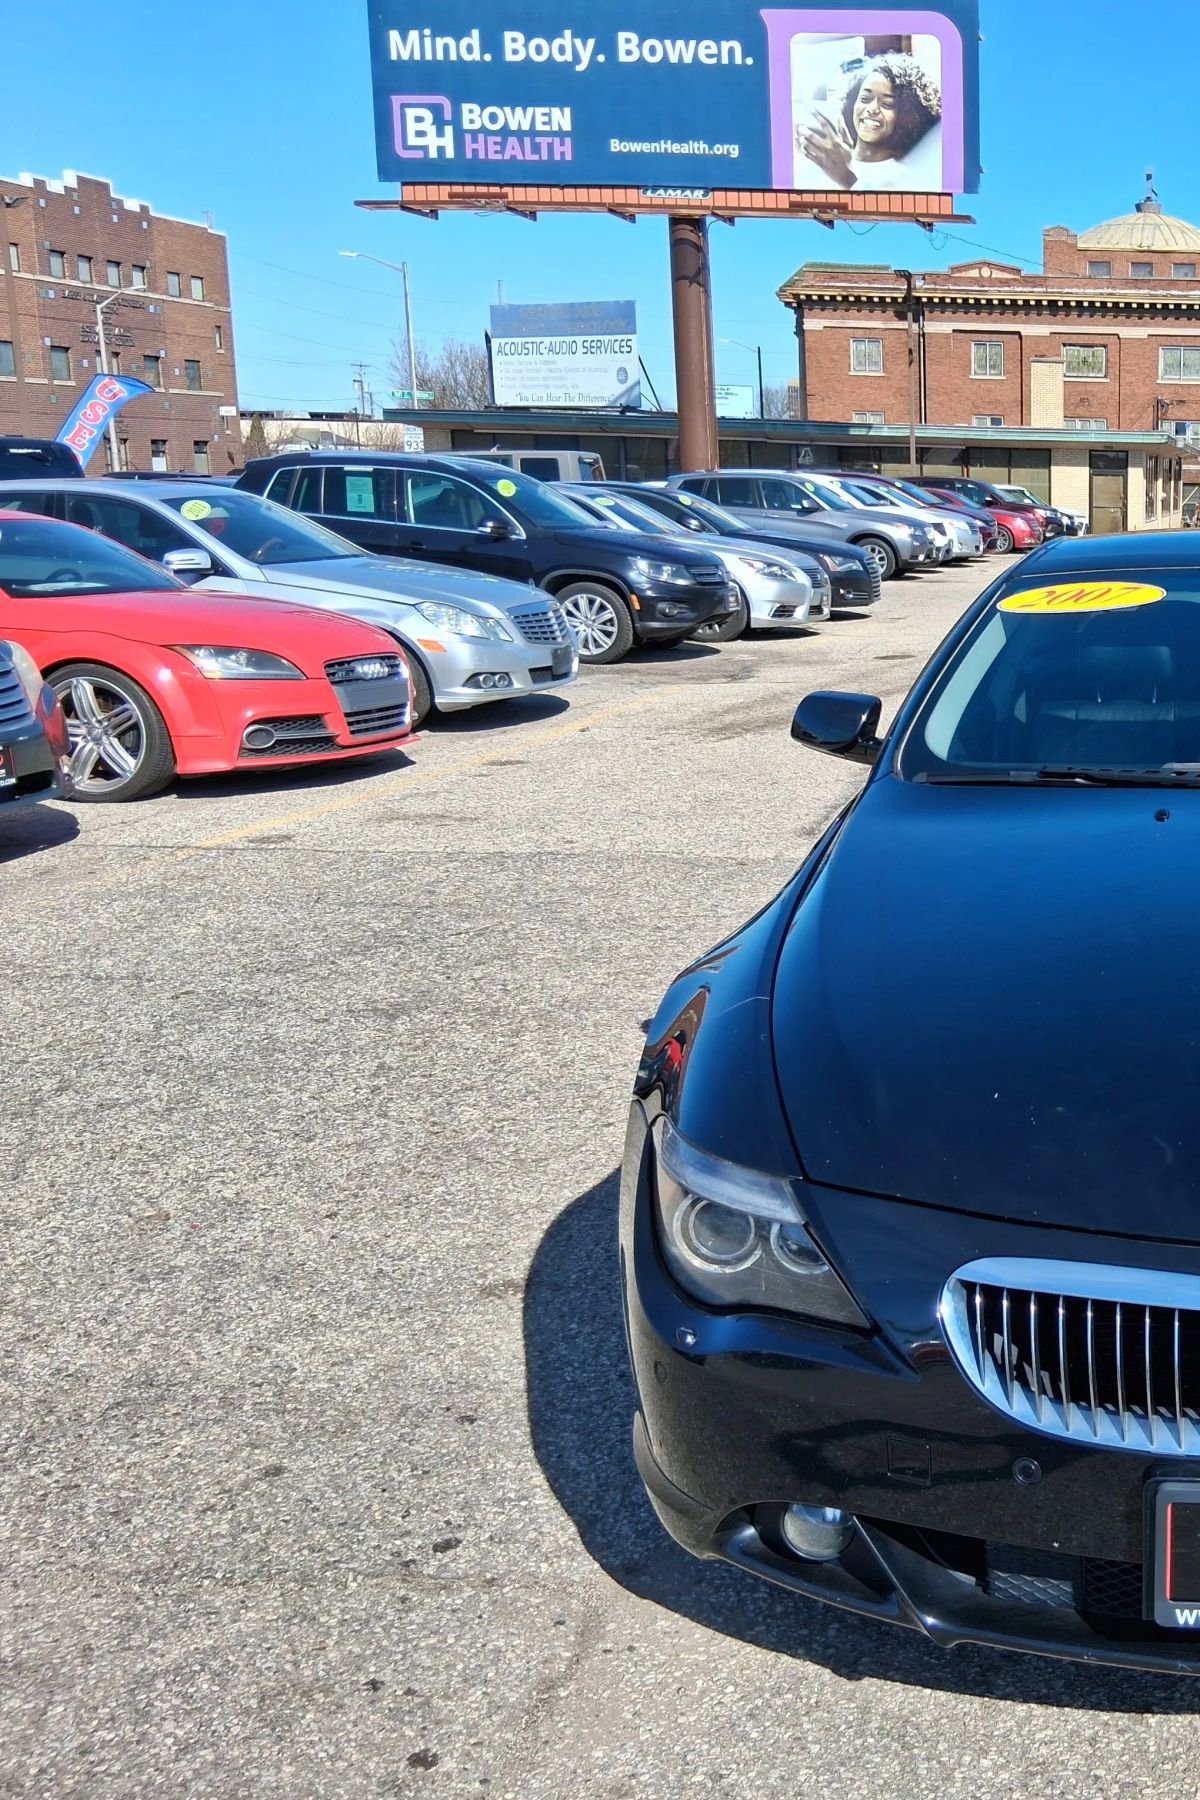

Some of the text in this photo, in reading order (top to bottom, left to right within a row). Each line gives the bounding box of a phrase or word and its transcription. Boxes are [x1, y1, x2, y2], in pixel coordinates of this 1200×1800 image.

[388, 28, 755, 71] Mind. Body. Bowen.
[461, 103, 572, 132] BOWEN
[464, 134, 573, 161] HEALTH
[610, 138, 740, 158] BowenHealth.org
[646, 188, 704, 198] LAMAR
[582, 338, 633, 355] SERVICES
[63, 377, 127, 464] USE
[1016, 587, 1144, 609] 2007
